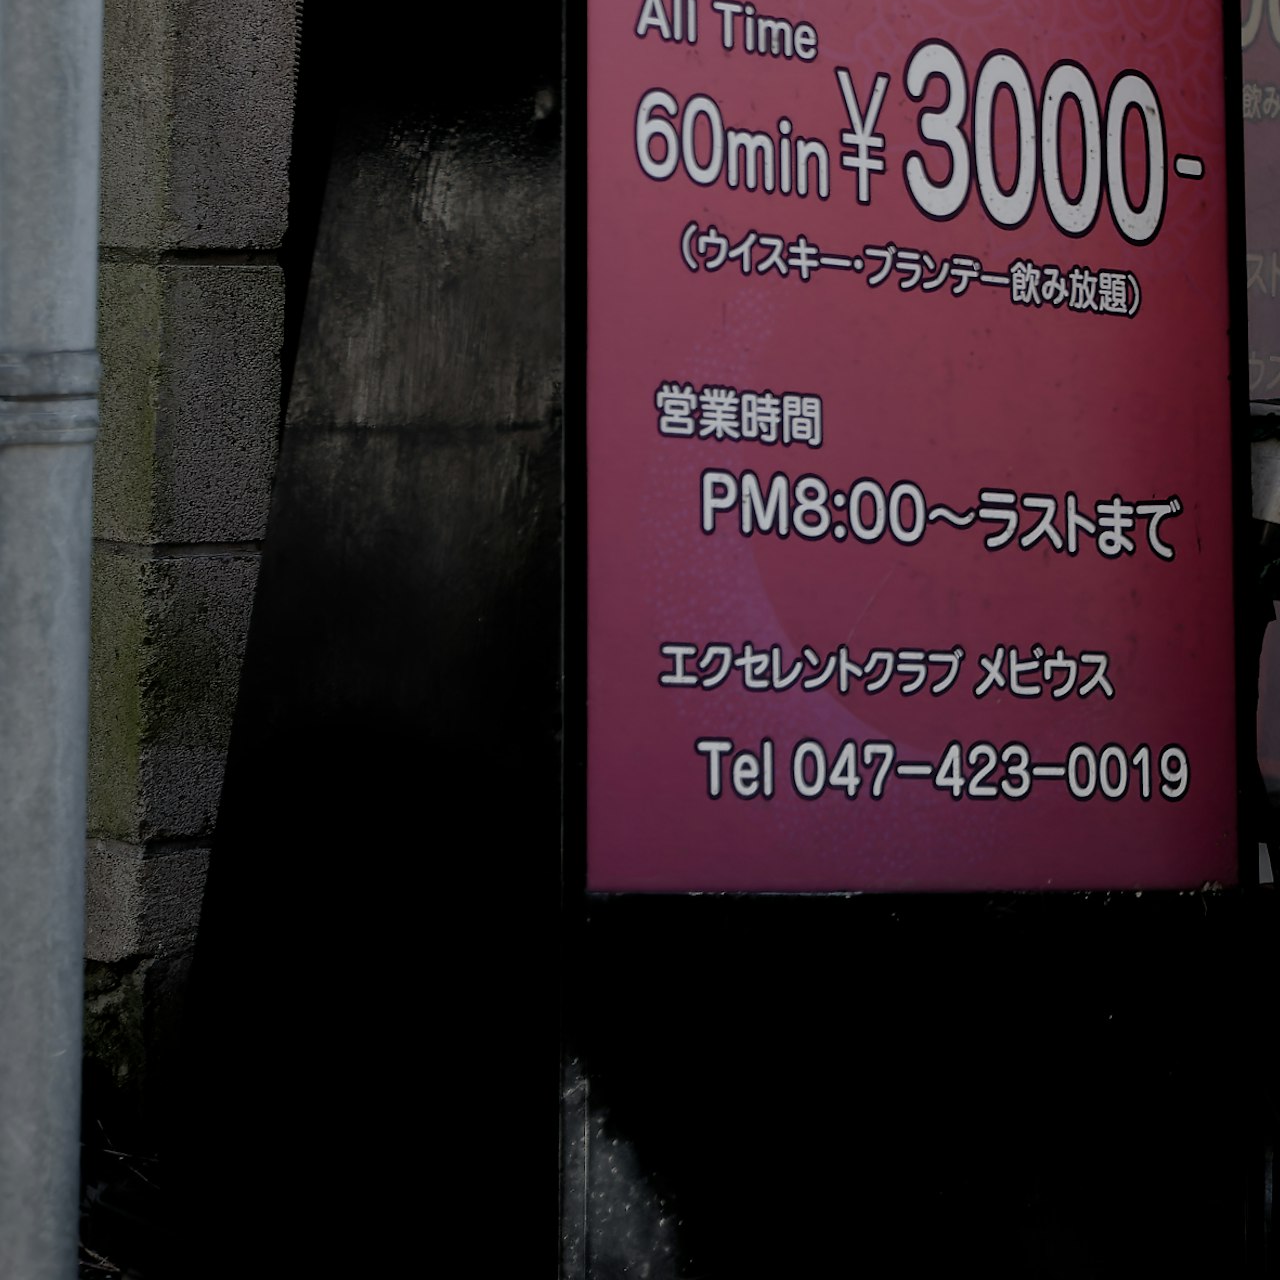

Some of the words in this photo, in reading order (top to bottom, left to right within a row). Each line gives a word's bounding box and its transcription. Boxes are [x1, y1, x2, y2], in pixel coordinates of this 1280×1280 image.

[713, 0, 819, 62] Time
[634, 87, 831, 200] 60min
[654, 382, 824, 448] 営業時間
[659, 643, 965, 696] エクセレントクラブ
[974, 645, 1115, 700] メビウス
[696, 739, 774, 799] Tel
[792, 741, 1190, 800] 047-423-0019
